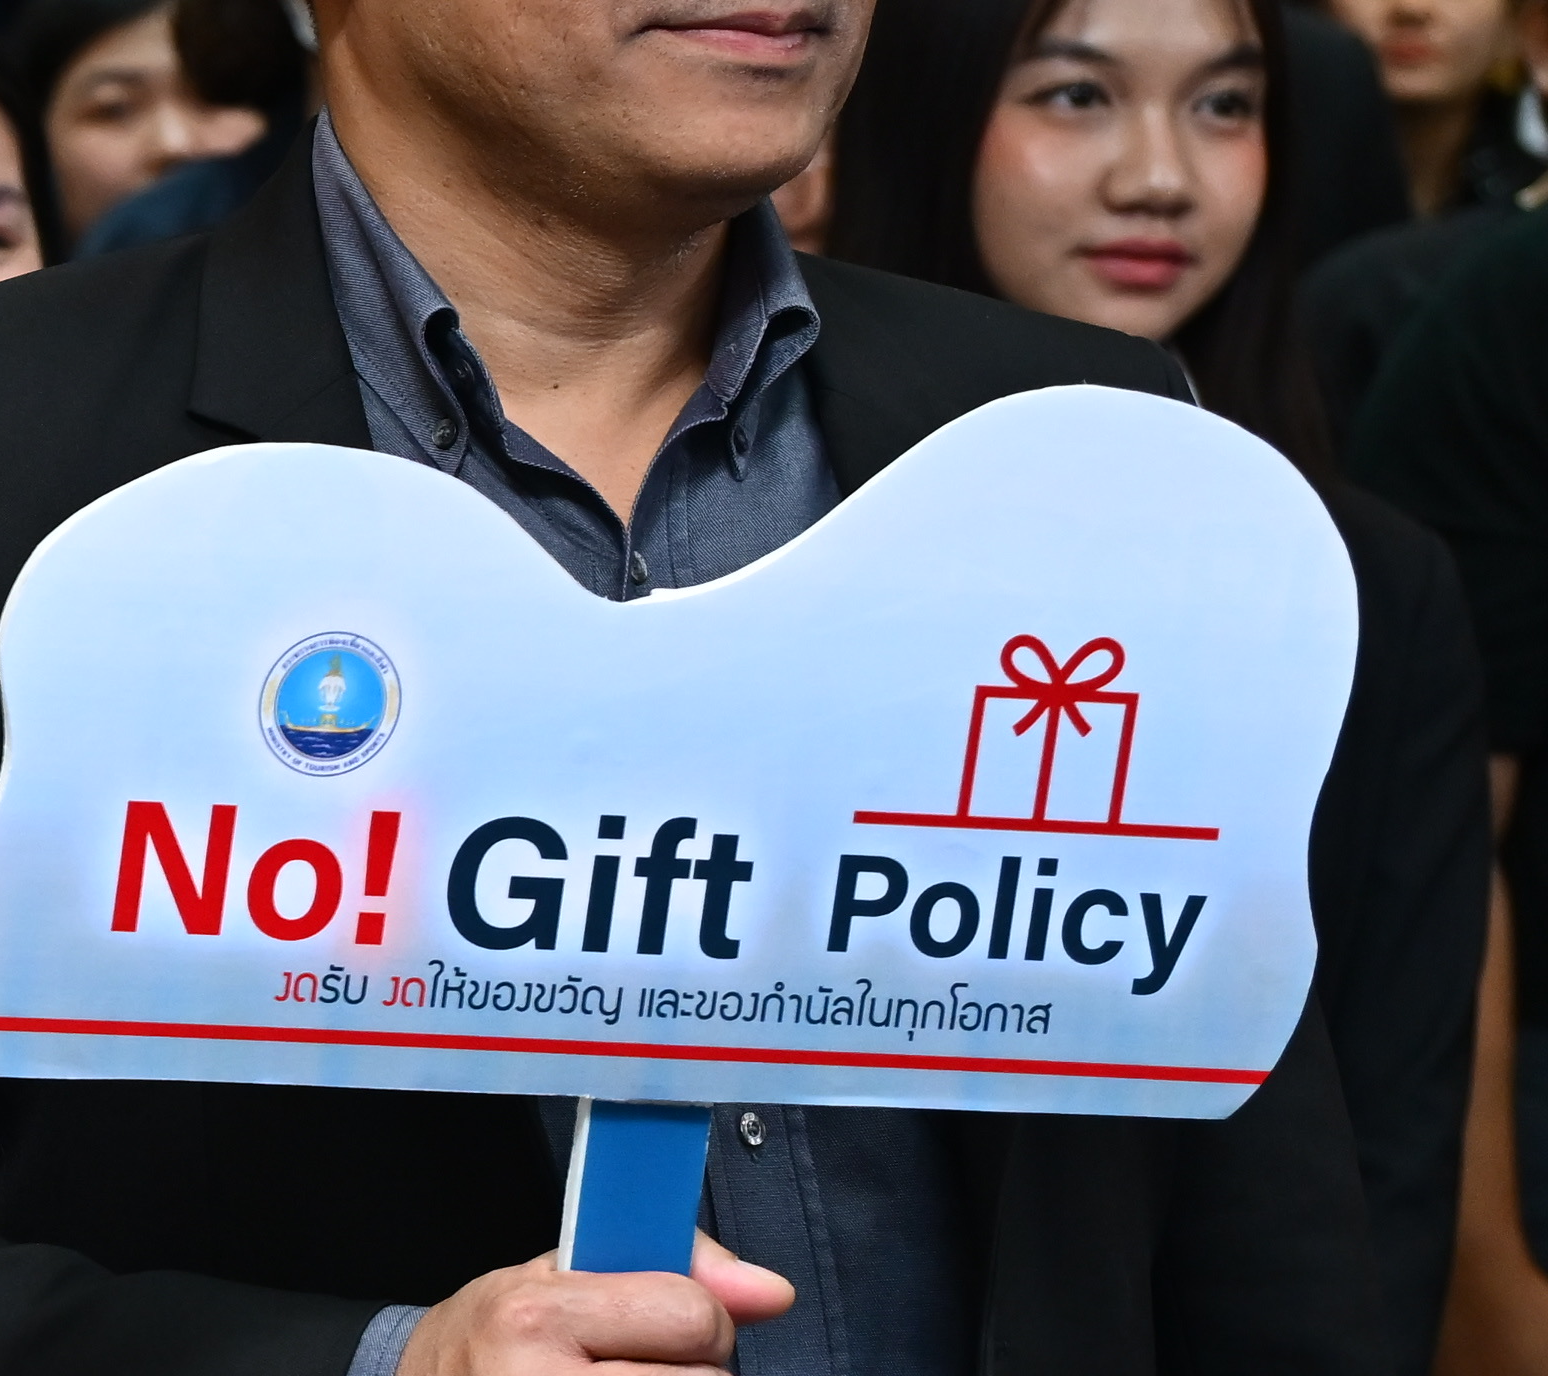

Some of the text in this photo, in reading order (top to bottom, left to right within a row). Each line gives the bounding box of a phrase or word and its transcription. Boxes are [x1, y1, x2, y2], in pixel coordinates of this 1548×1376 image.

[111, 800, 1208, 996] No! Gift Policy
[273, 959, 1054, 1042] งดรับ งดให้ของขวัญ และของกำนัลในทุกโอกาส
